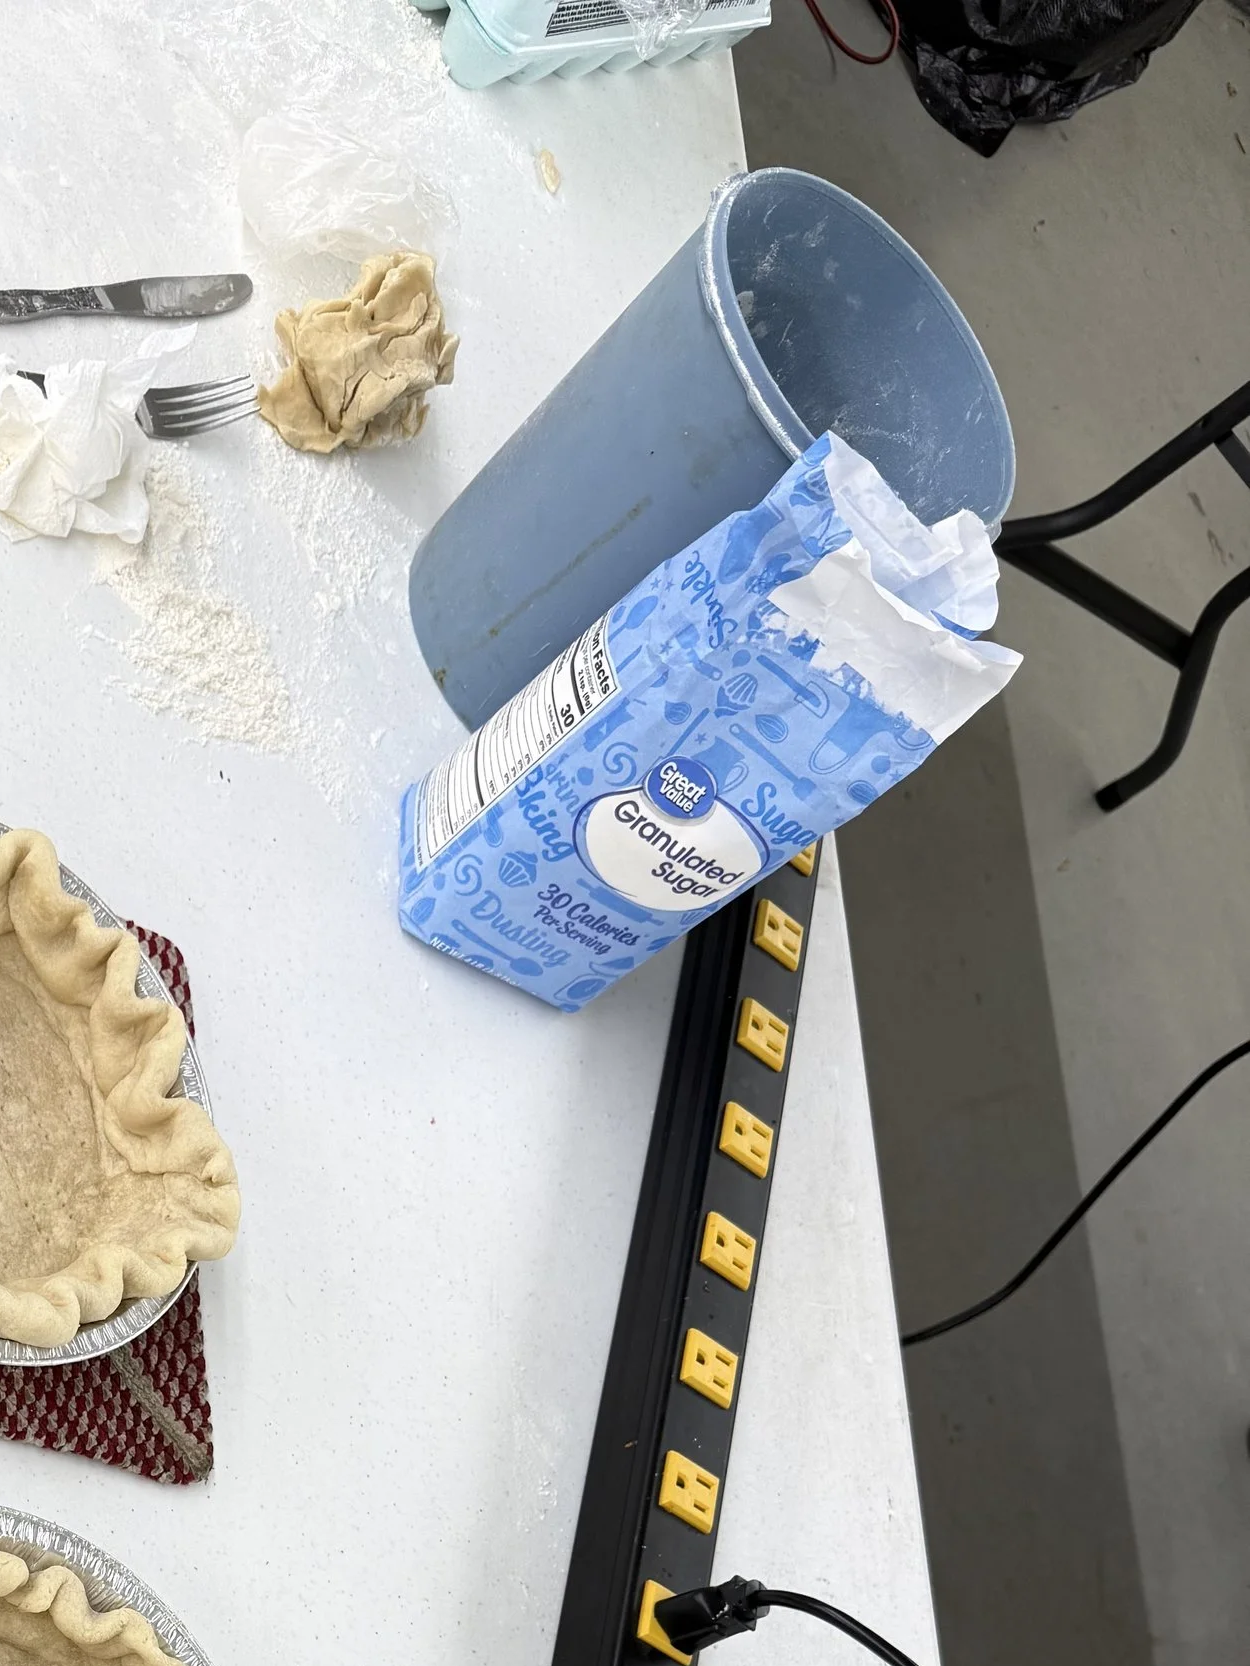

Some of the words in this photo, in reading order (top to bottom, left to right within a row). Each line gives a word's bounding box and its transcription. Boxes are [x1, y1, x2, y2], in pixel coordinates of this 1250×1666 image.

[592, 648, 610, 695] Facts
[560, 703, 575, 728] 30
[659, 761, 708, 804] Great
[659, 781, 694, 814] Value
[514, 763, 575, 864] Bking
[740, 781, 820, 847] Suga
[614, 800, 746, 886] Granulated
[469, 889, 571, 968] Dusting
[533, 904, 557, 929] Per
[556, 920, 611, 956] Serving
[537, 883, 573, 909] 30
[566, 902, 641, 947] Calories
[429, 935, 451, 952] NET
